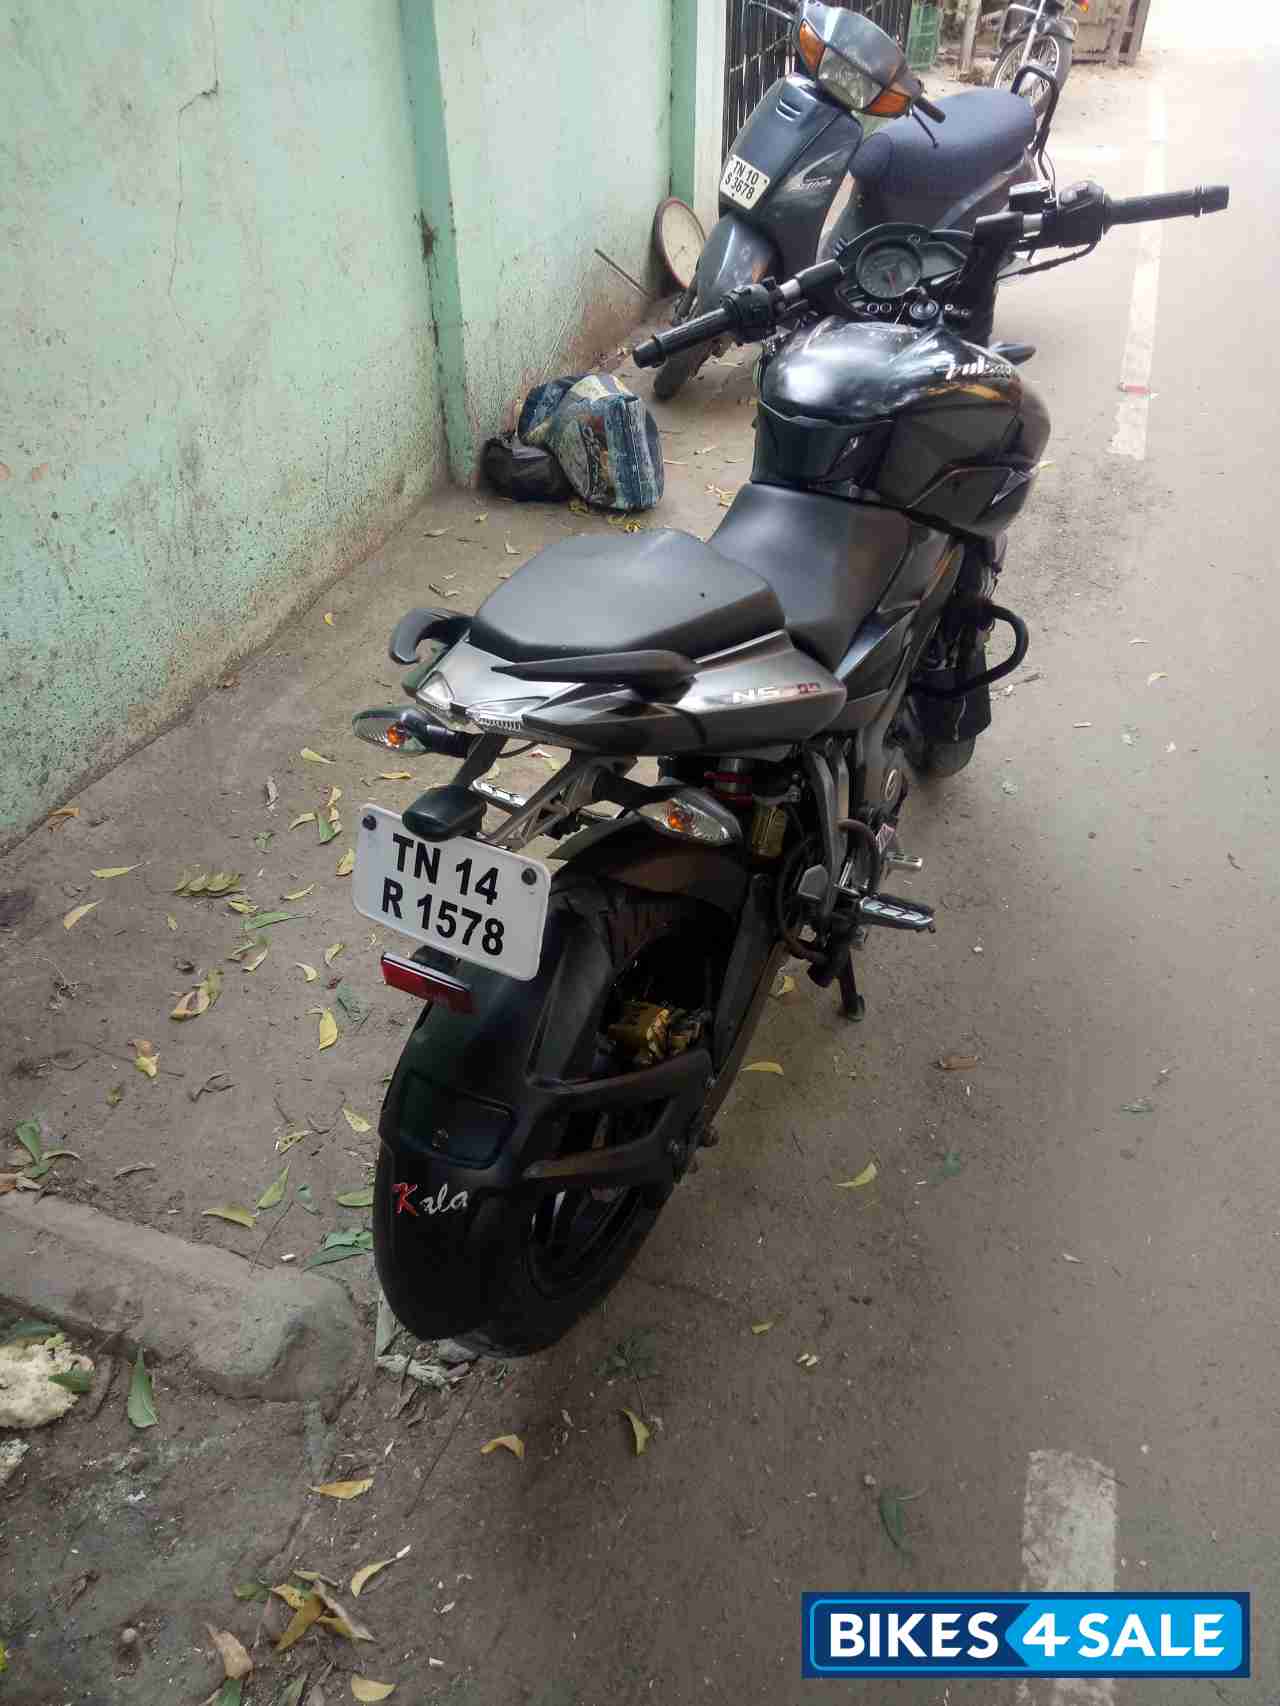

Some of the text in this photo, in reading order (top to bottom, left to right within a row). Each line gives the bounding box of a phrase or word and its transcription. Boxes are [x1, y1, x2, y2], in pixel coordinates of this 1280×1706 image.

[725, 173, 755, 200] S 3678
[733, 161, 760, 185] TN 10
[393, 833, 499, 905] TN 14
[382, 877, 505, 956] R 1578
